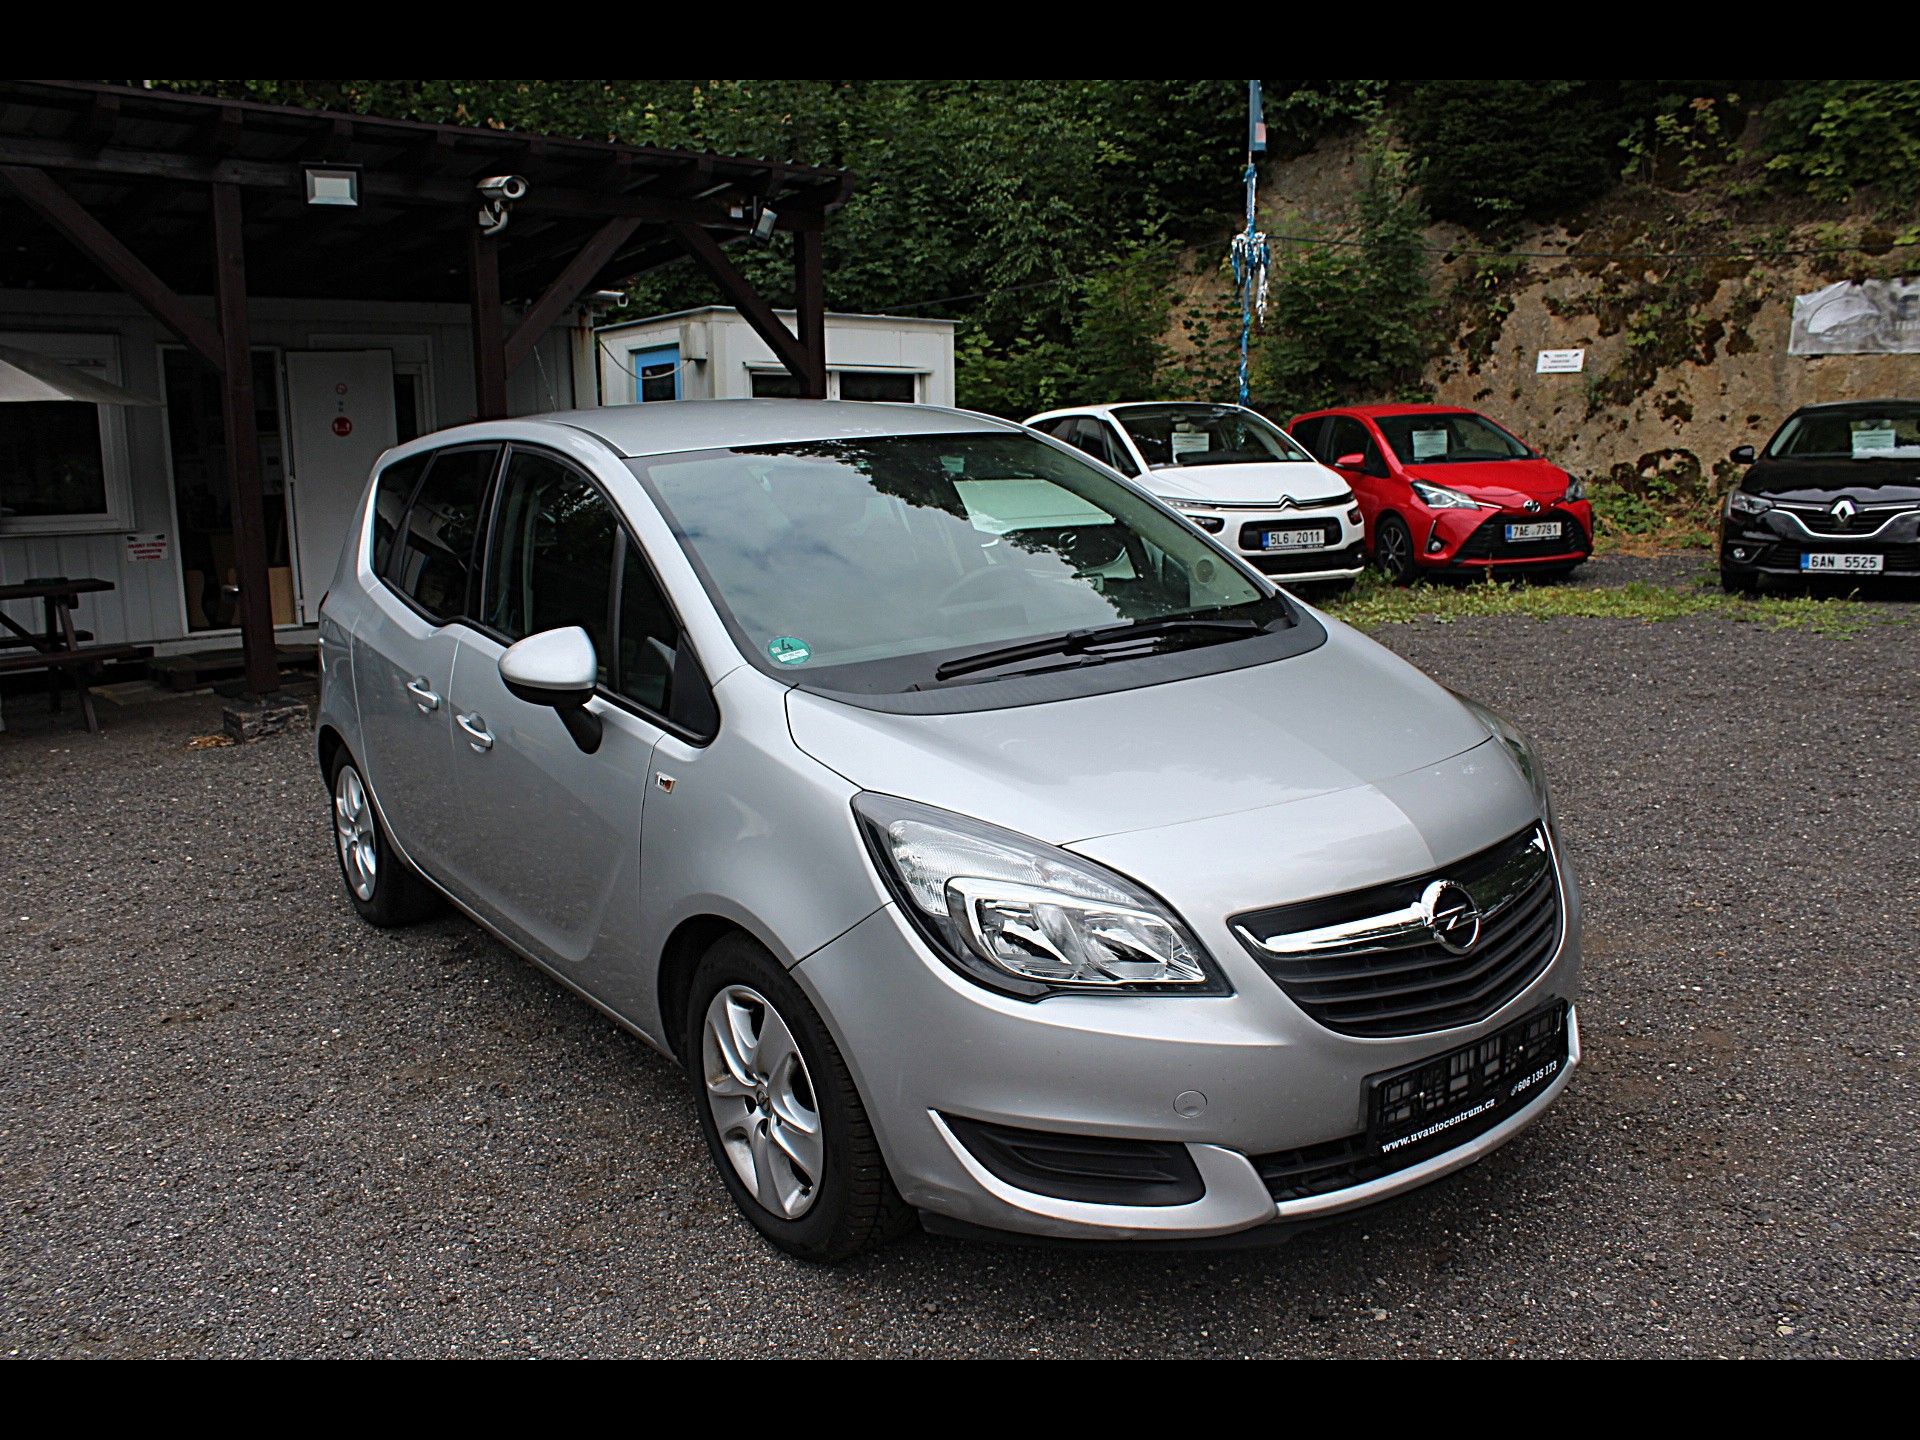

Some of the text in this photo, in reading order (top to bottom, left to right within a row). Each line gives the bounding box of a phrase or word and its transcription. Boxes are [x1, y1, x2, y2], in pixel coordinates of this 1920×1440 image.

[1513, 524, 1557, 537] 7AE 7791
[1270, 531, 1320, 545] 5L6 2011
[1811, 555, 1877, 569] 6AN 5525
[780, 639, 794, 651] 4
[1517, 1060, 1557, 1092] 606 135 173
[1381, 1098, 1496, 1153] www.uvautocentrum.cz
